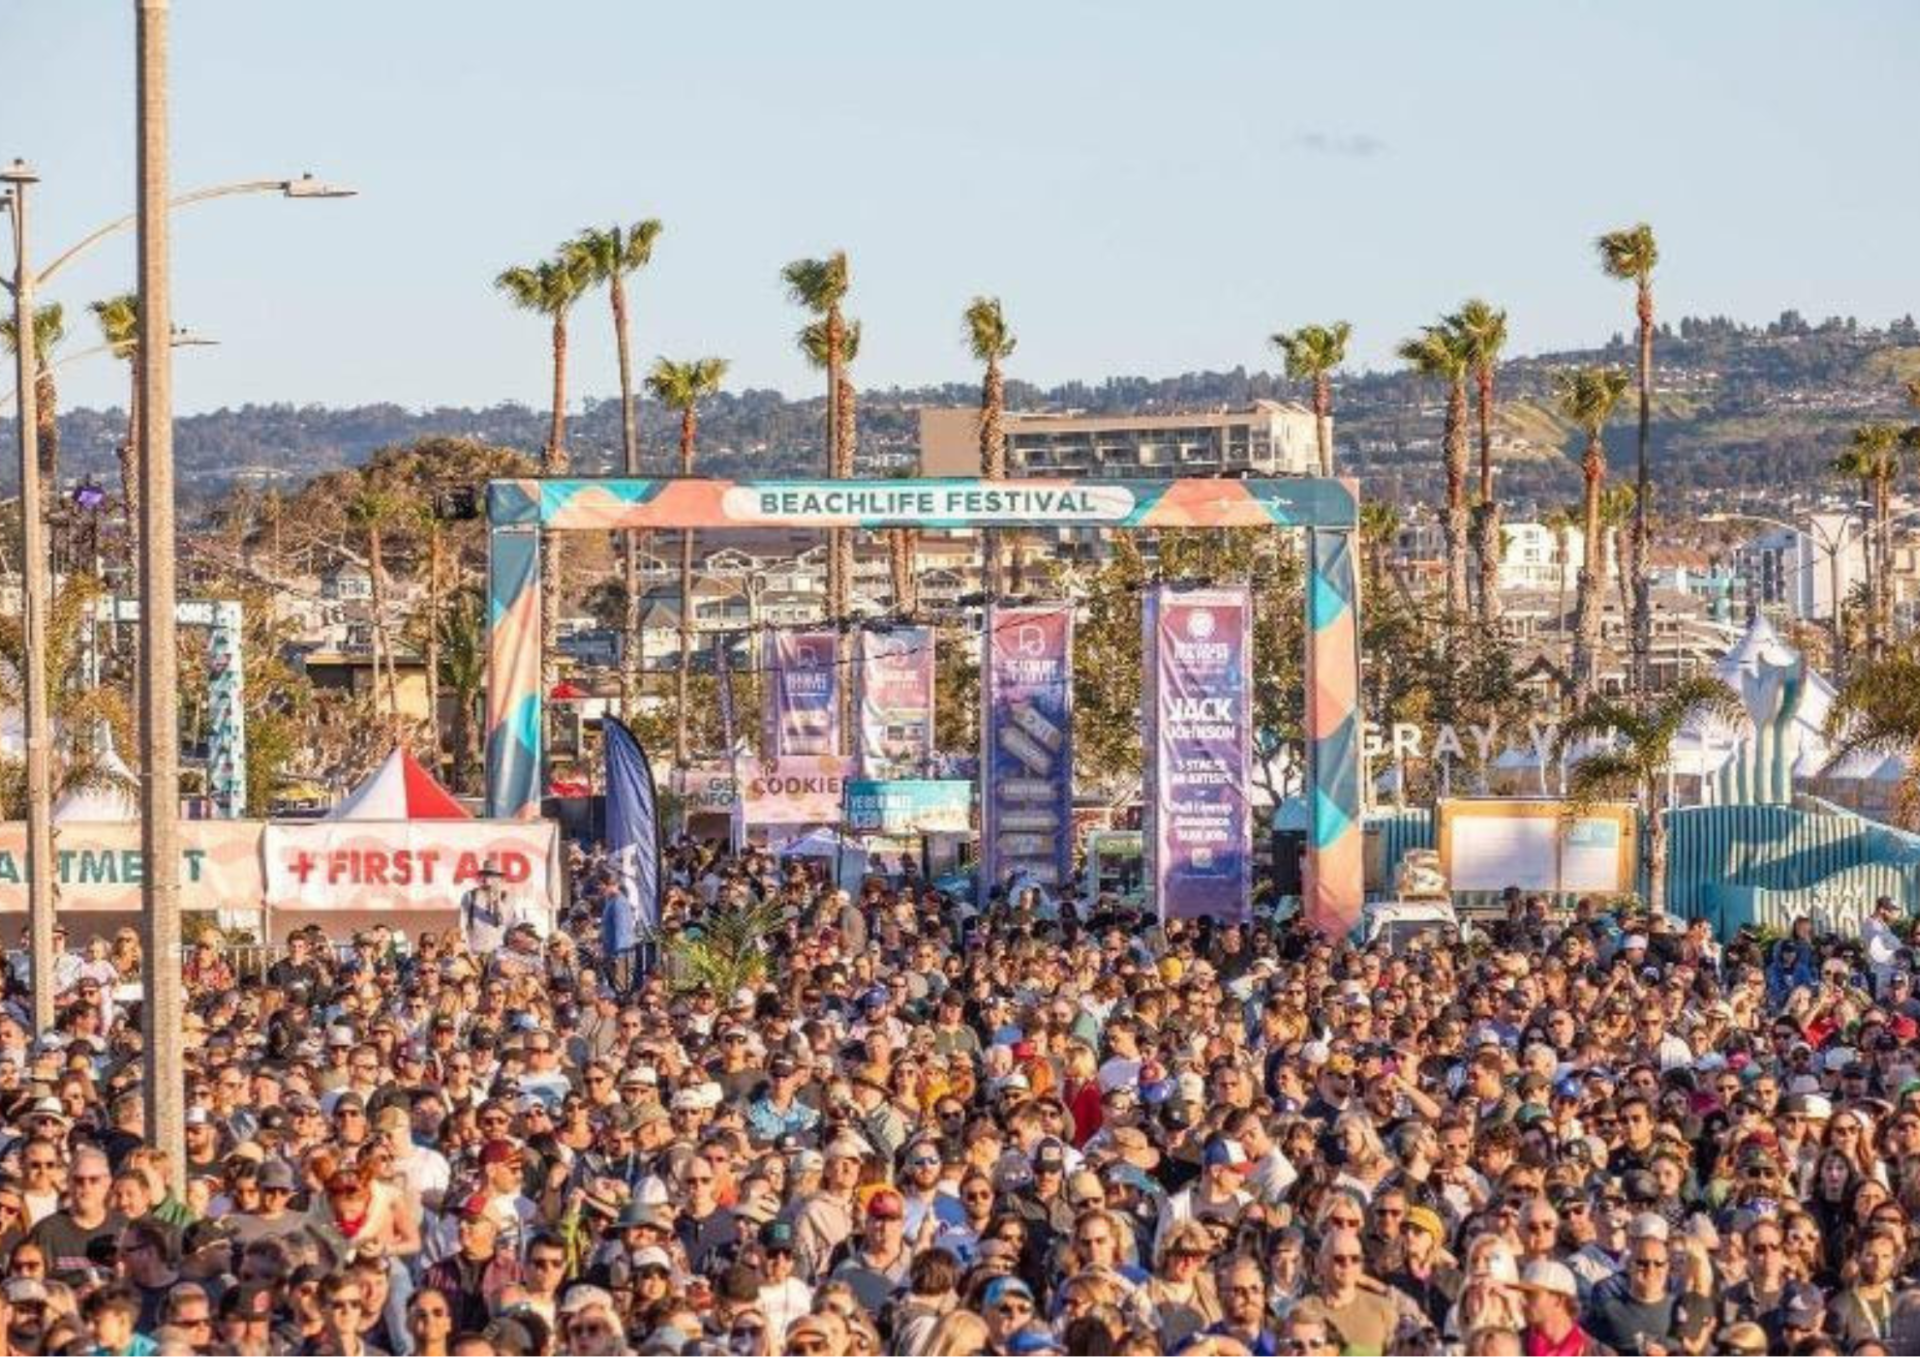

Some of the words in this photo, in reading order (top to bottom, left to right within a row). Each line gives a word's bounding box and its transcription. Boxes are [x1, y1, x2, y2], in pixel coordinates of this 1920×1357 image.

[760, 492, 934, 514] BEACHLIFE
[946, 490, 1097, 512] FESTIVAL
[1170, 698, 1233, 721] JACK
[1361, 721, 1498, 759] GRAY
[328, 850, 440, 885] FIRST
